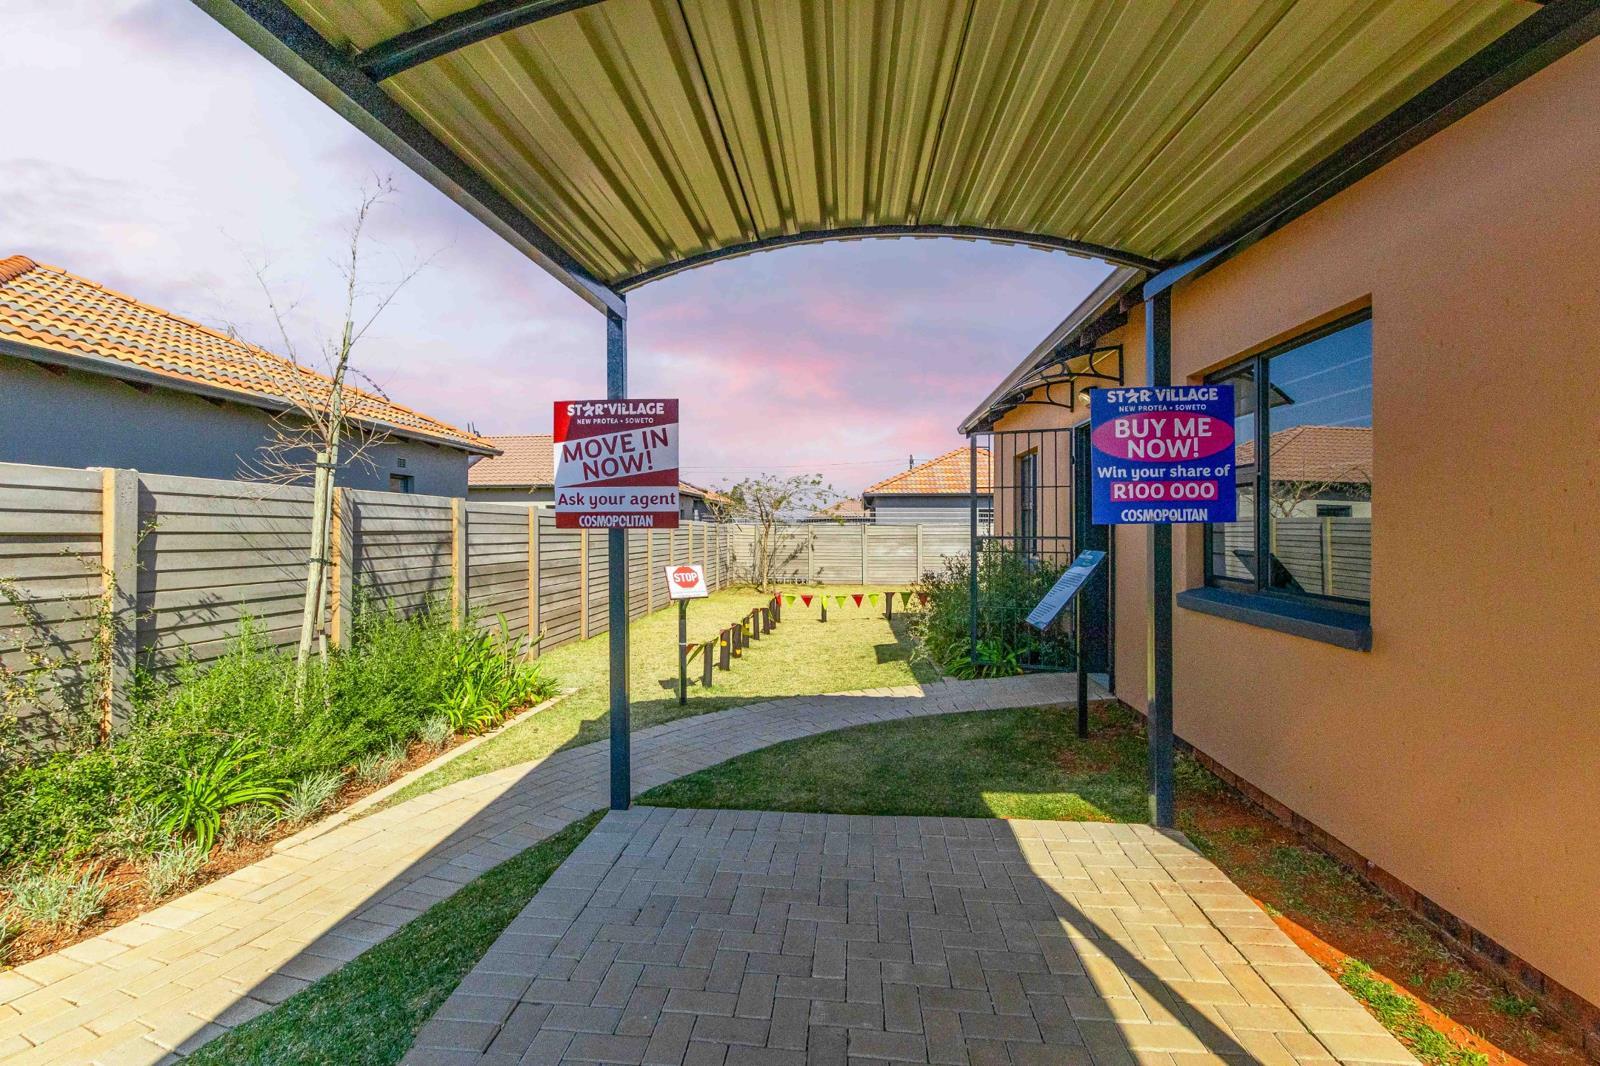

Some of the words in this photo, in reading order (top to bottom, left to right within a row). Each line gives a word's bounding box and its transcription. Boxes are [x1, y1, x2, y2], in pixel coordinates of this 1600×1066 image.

[1114, 418, 1167, 438] BUY
[1174, 417, 1212, 437] ME
[562, 433, 636, 463] MOVE
[641, 427, 669, 450] IN
[1127, 437, 1199, 459] NOW!
[582, 450, 653, 481] NOW!
[1097, 466, 1128, 478] Win
[1131, 467, 1166, 481] your
[1170, 465, 1211, 477] share
[1214, 464, 1231, 477] of
[1113, 483, 1165, 499] R100
[1169, 482, 1215, 499] 000
[558, 492, 585, 506] Ask
[589, 494, 626, 509] your
[630, 493, 676, 508] agent
[578, 515, 654, 528] COSMOPOLITAN
[1121, 508, 1208, 522] COSMOPOLITAN
[673, 572, 698, 583] STOP
